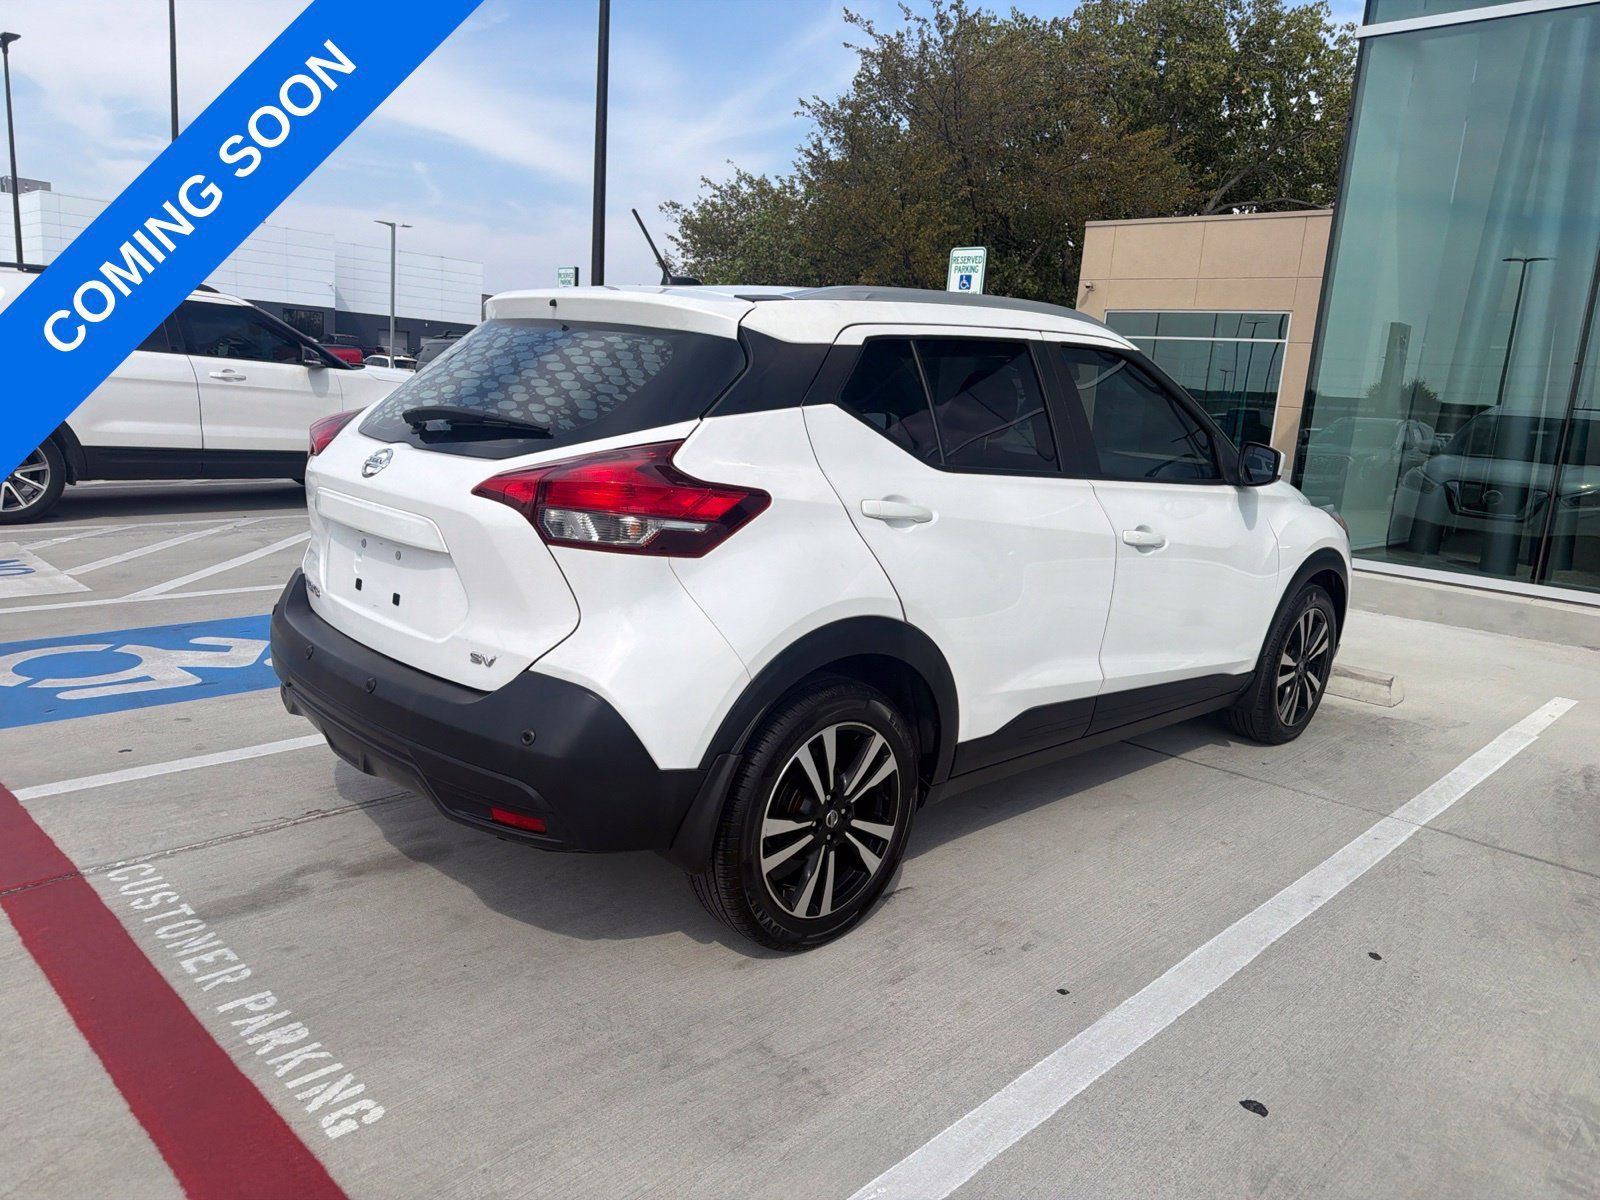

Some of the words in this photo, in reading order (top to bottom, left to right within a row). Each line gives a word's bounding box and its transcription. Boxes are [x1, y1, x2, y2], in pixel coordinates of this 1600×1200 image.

[952, 255, 983, 264] RESERVED
[954, 265, 979, 274] PARKING
[470, 652, 497, 668] SV
[216, 990, 386, 1140] PARKING
